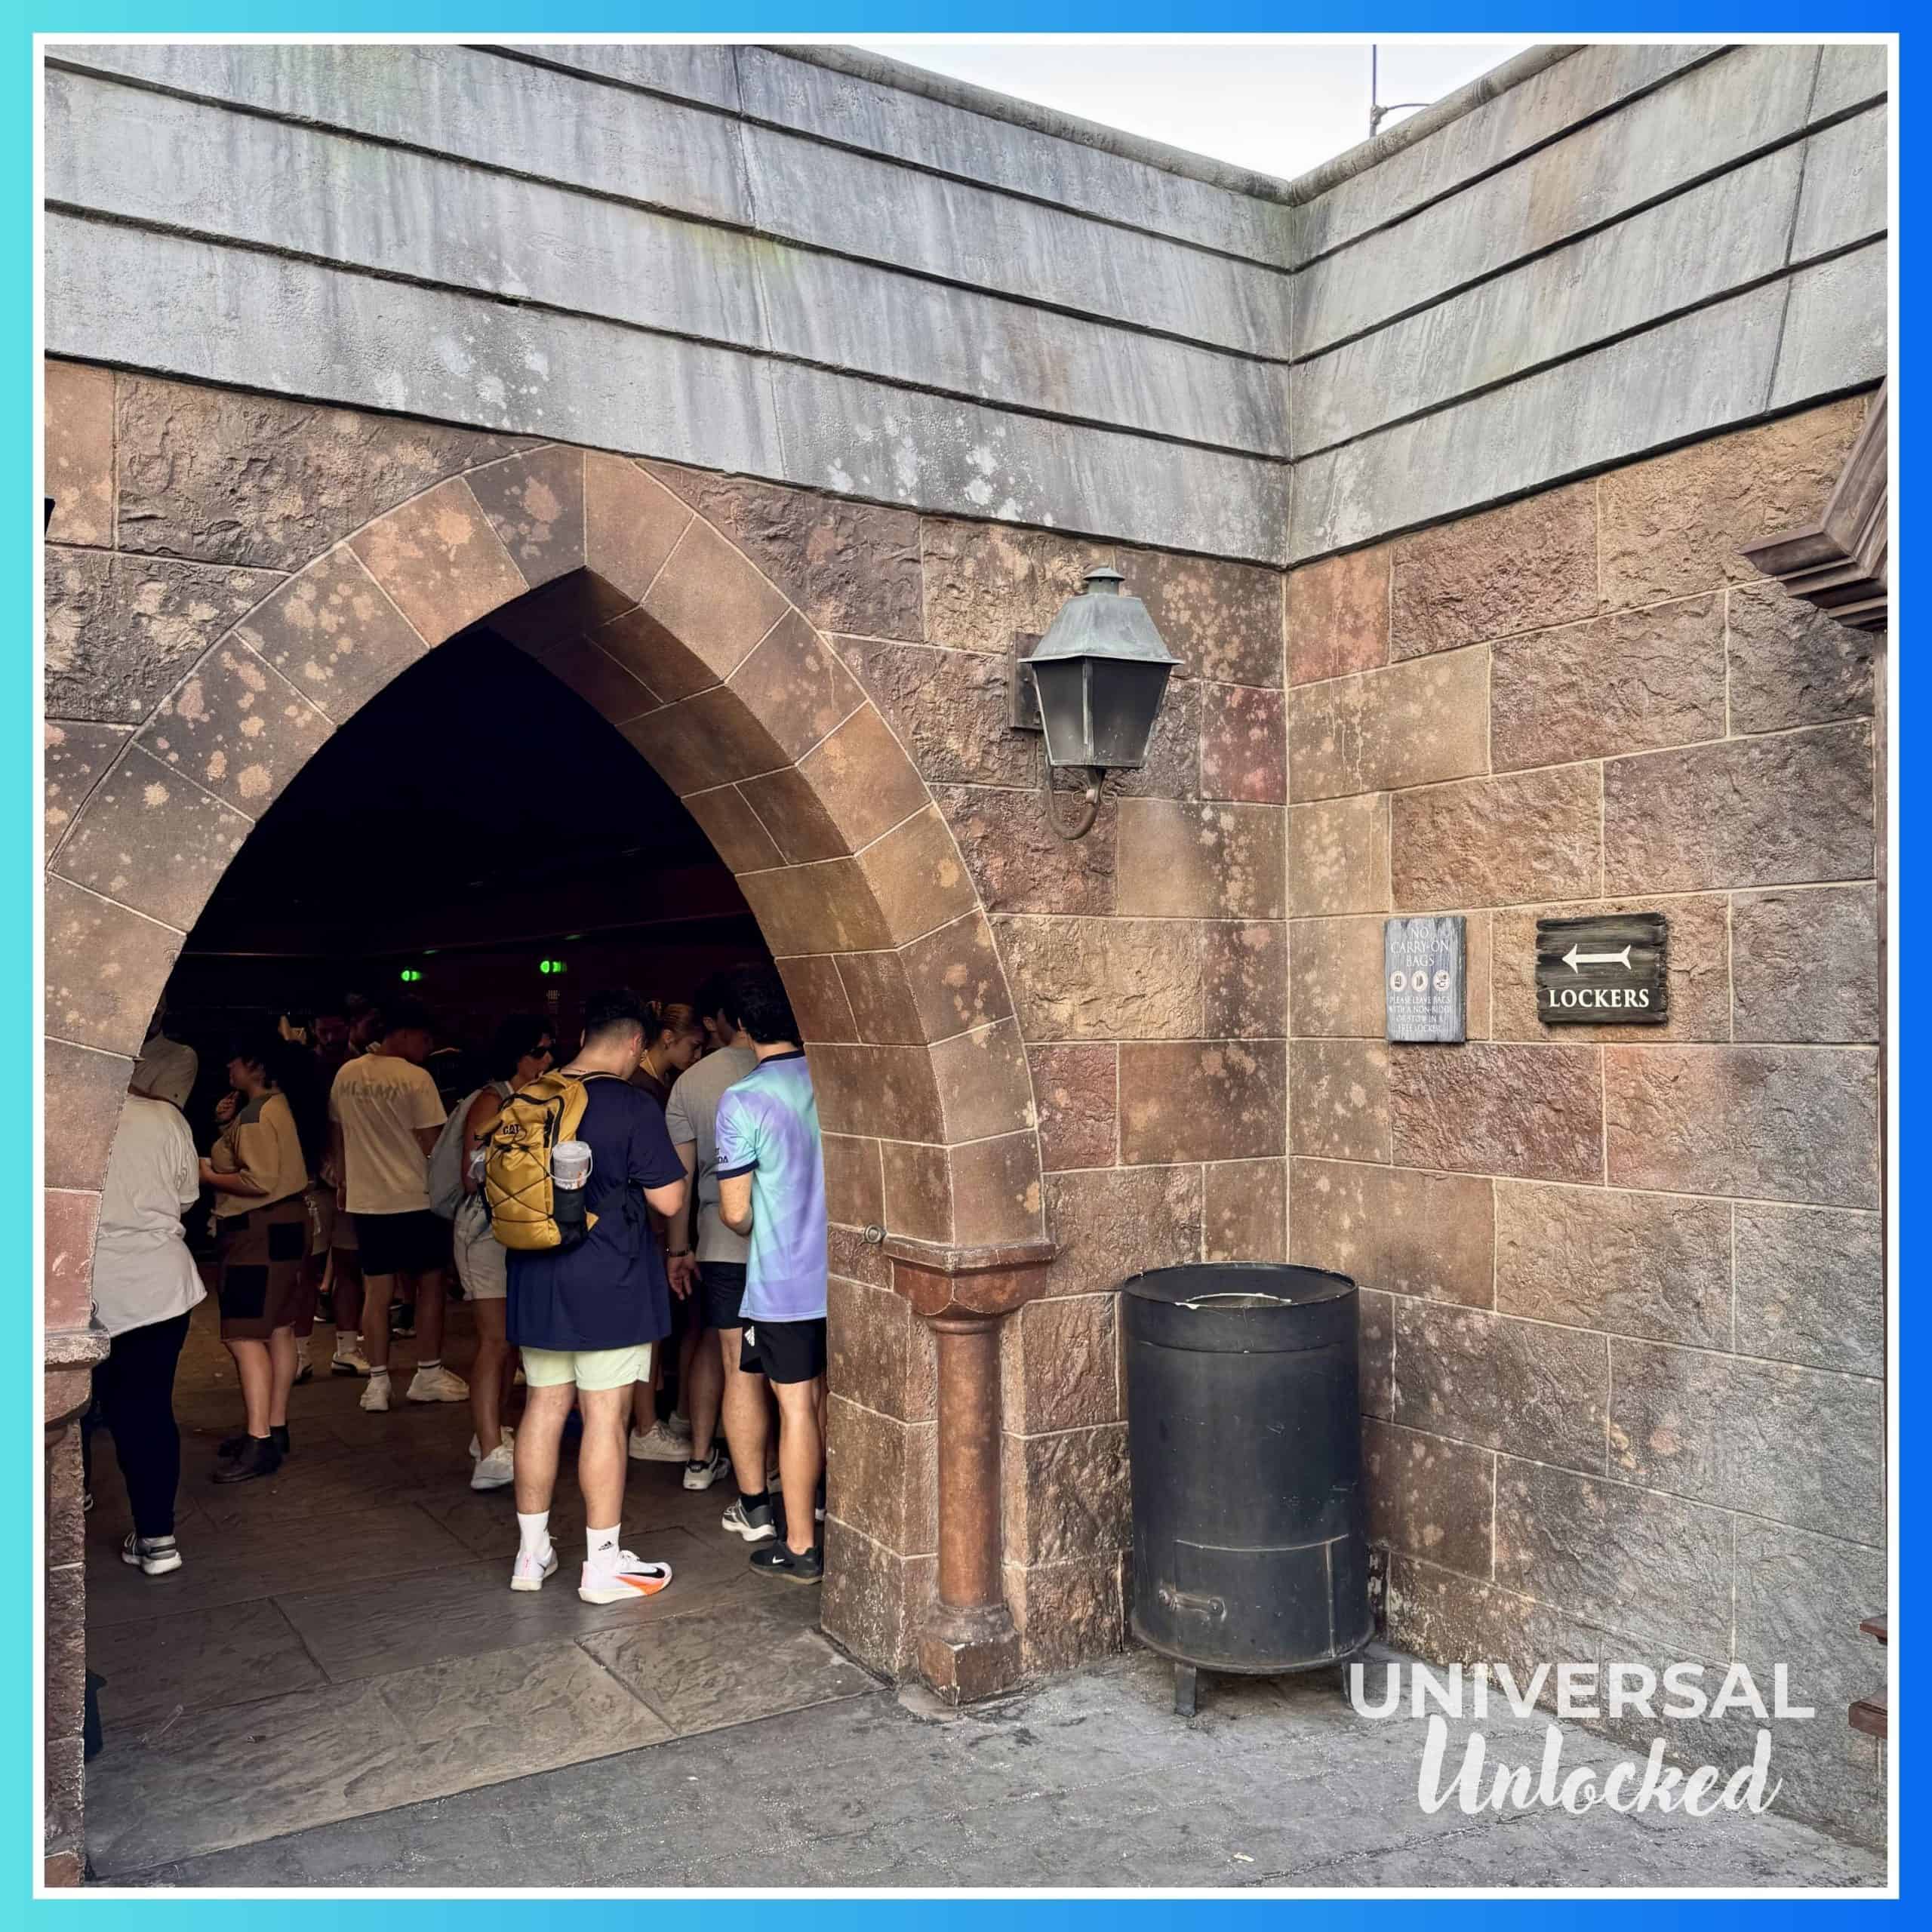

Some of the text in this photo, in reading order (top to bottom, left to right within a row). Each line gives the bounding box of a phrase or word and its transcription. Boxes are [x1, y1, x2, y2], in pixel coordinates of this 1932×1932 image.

[1411, 927, 1429, 939] NO
[1390, 940, 1449, 954] CARRY-ON
[1406, 954, 1435, 968] BAGS
[1433, 995, 1451, 1004] BAGS
[1549, 989, 1650, 1008] LOCKERS
